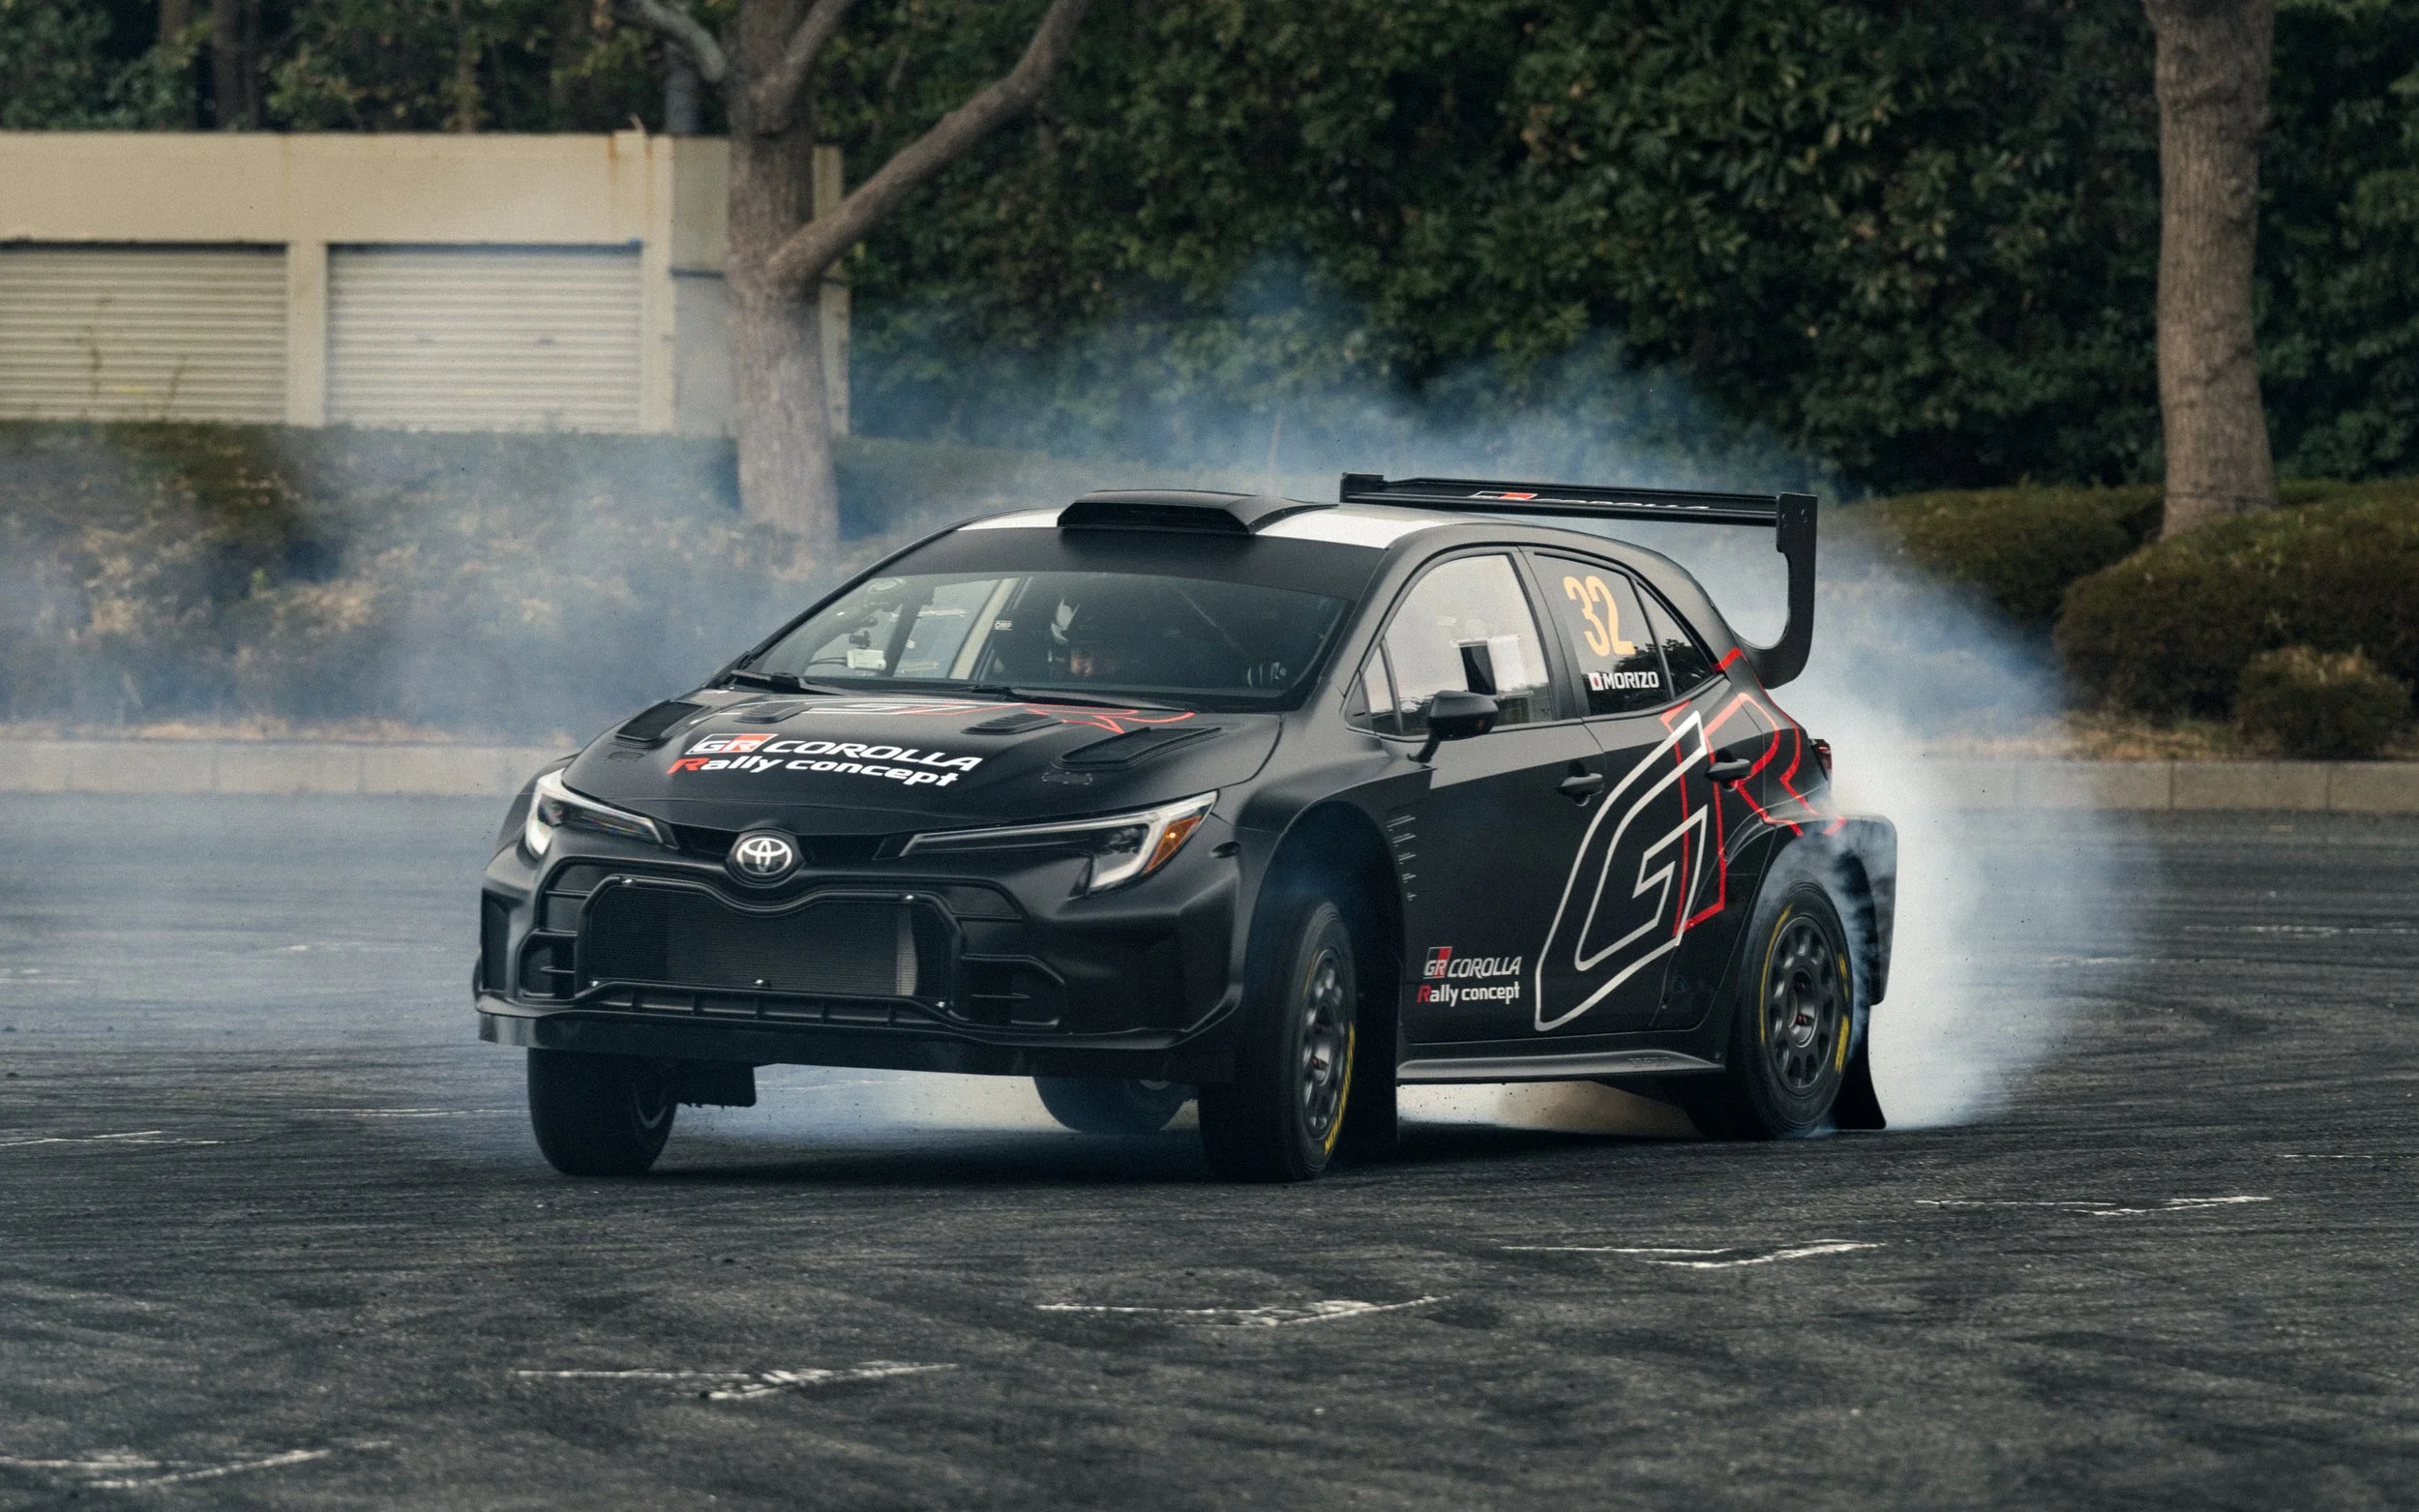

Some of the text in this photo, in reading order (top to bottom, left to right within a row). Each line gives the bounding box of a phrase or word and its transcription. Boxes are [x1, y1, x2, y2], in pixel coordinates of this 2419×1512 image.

[1563, 576, 1637, 657] 32
[1602, 671, 1659, 690] MORIZO
[762, 740, 983, 772] COROLLA
[666, 756, 959, 786] Rally concept
[1447, 956, 1522, 979] COROLLA
[1417, 981, 1520, 1007] Rally concept
